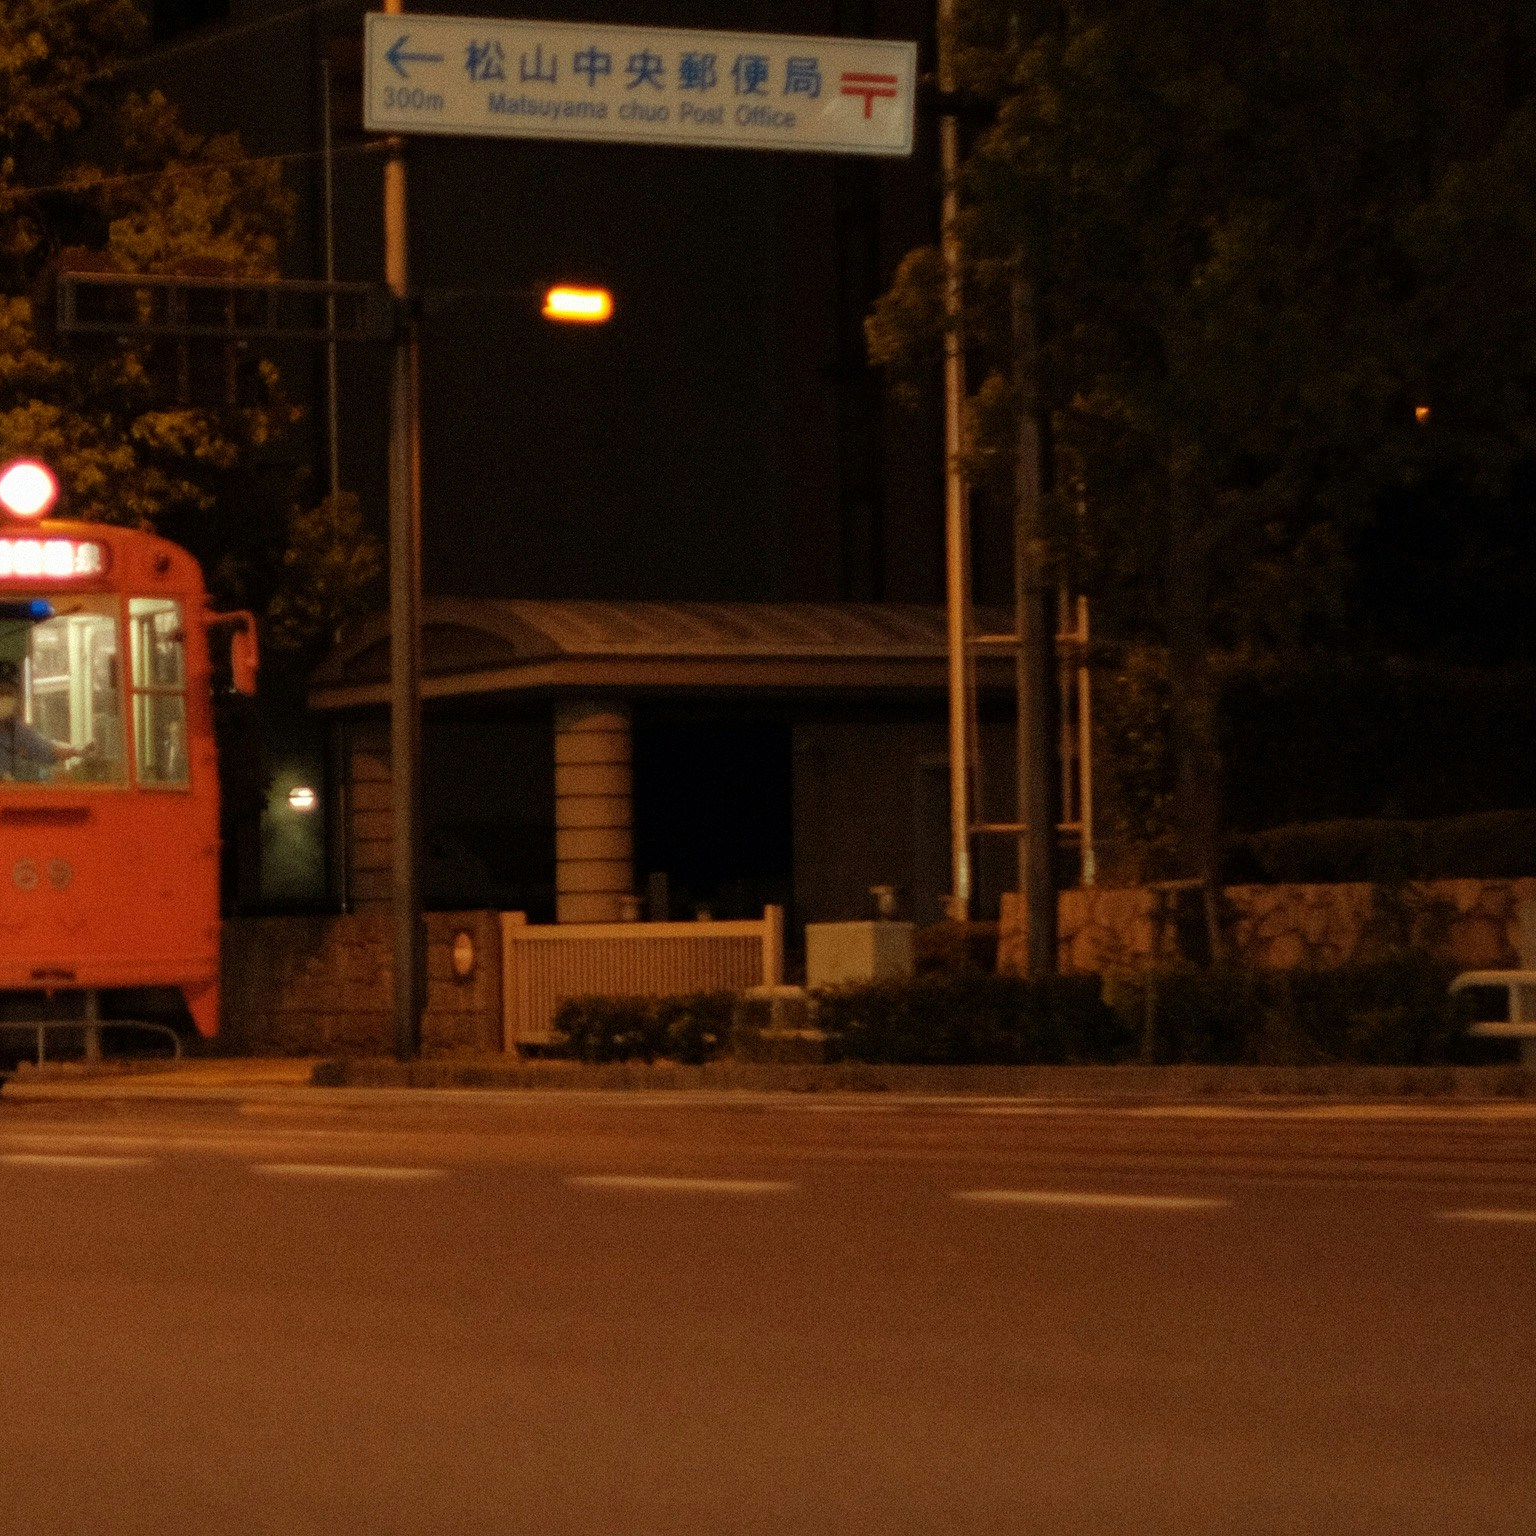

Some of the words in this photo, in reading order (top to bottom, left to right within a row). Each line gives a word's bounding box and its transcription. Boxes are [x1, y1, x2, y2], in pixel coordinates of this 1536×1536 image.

[465, 39, 822, 100] 松山中央郵便局
[384, 85, 444, 111] 300m
[487, 92, 608, 120] Matsuyama
[619, 99, 669, 123] chuo
[679, 101, 726, 125] Post
[735, 103, 797, 128] Office
[11, 857, 73, 891] 69
